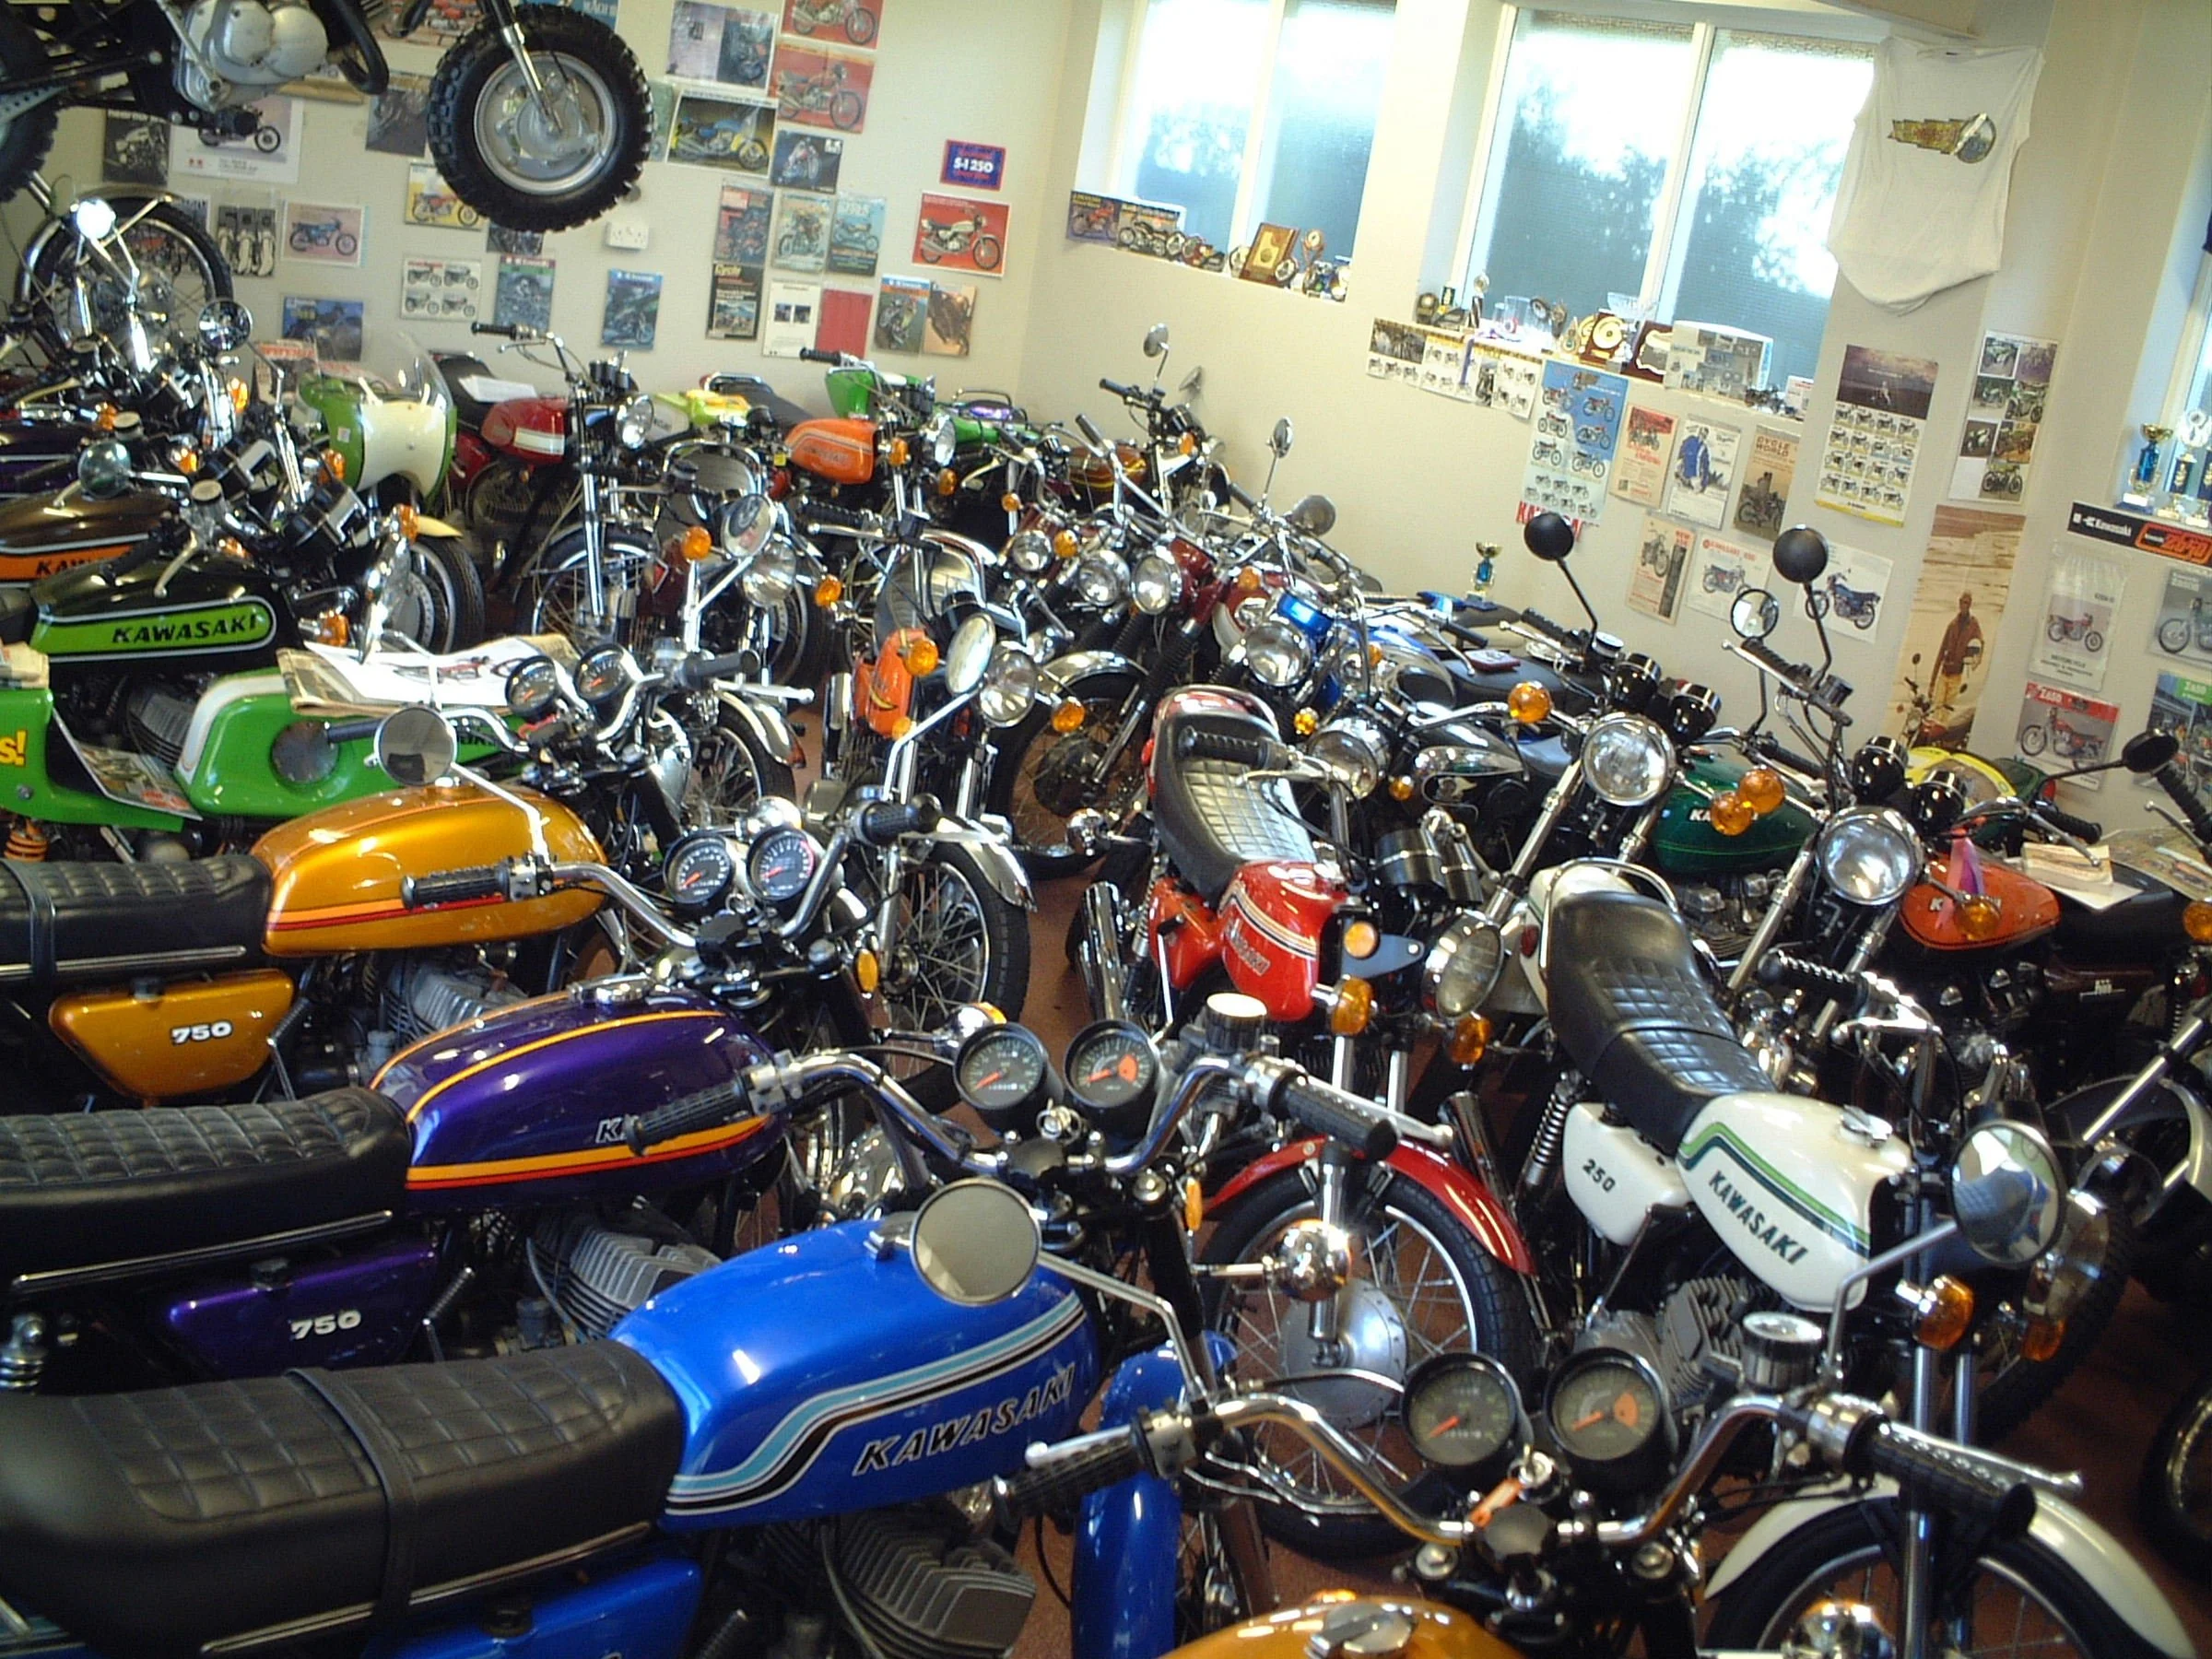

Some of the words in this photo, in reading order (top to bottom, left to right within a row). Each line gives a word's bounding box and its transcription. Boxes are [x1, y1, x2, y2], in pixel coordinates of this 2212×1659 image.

[970, 159, 994, 173] 250
[1756, 443, 1789, 457] WORLD
[1757, 435, 1791, 450] CYCLE
[112, 613, 257, 643] KAWASAKI
[169, 1018, 233, 1045] 750
[1582, 1158, 1618, 1194] 250
[1707, 1170, 1810, 1266] KAWASAKI
[289, 1309, 362, 1341] 750
[852, 1362, 1077, 1477] KAWASAKI
